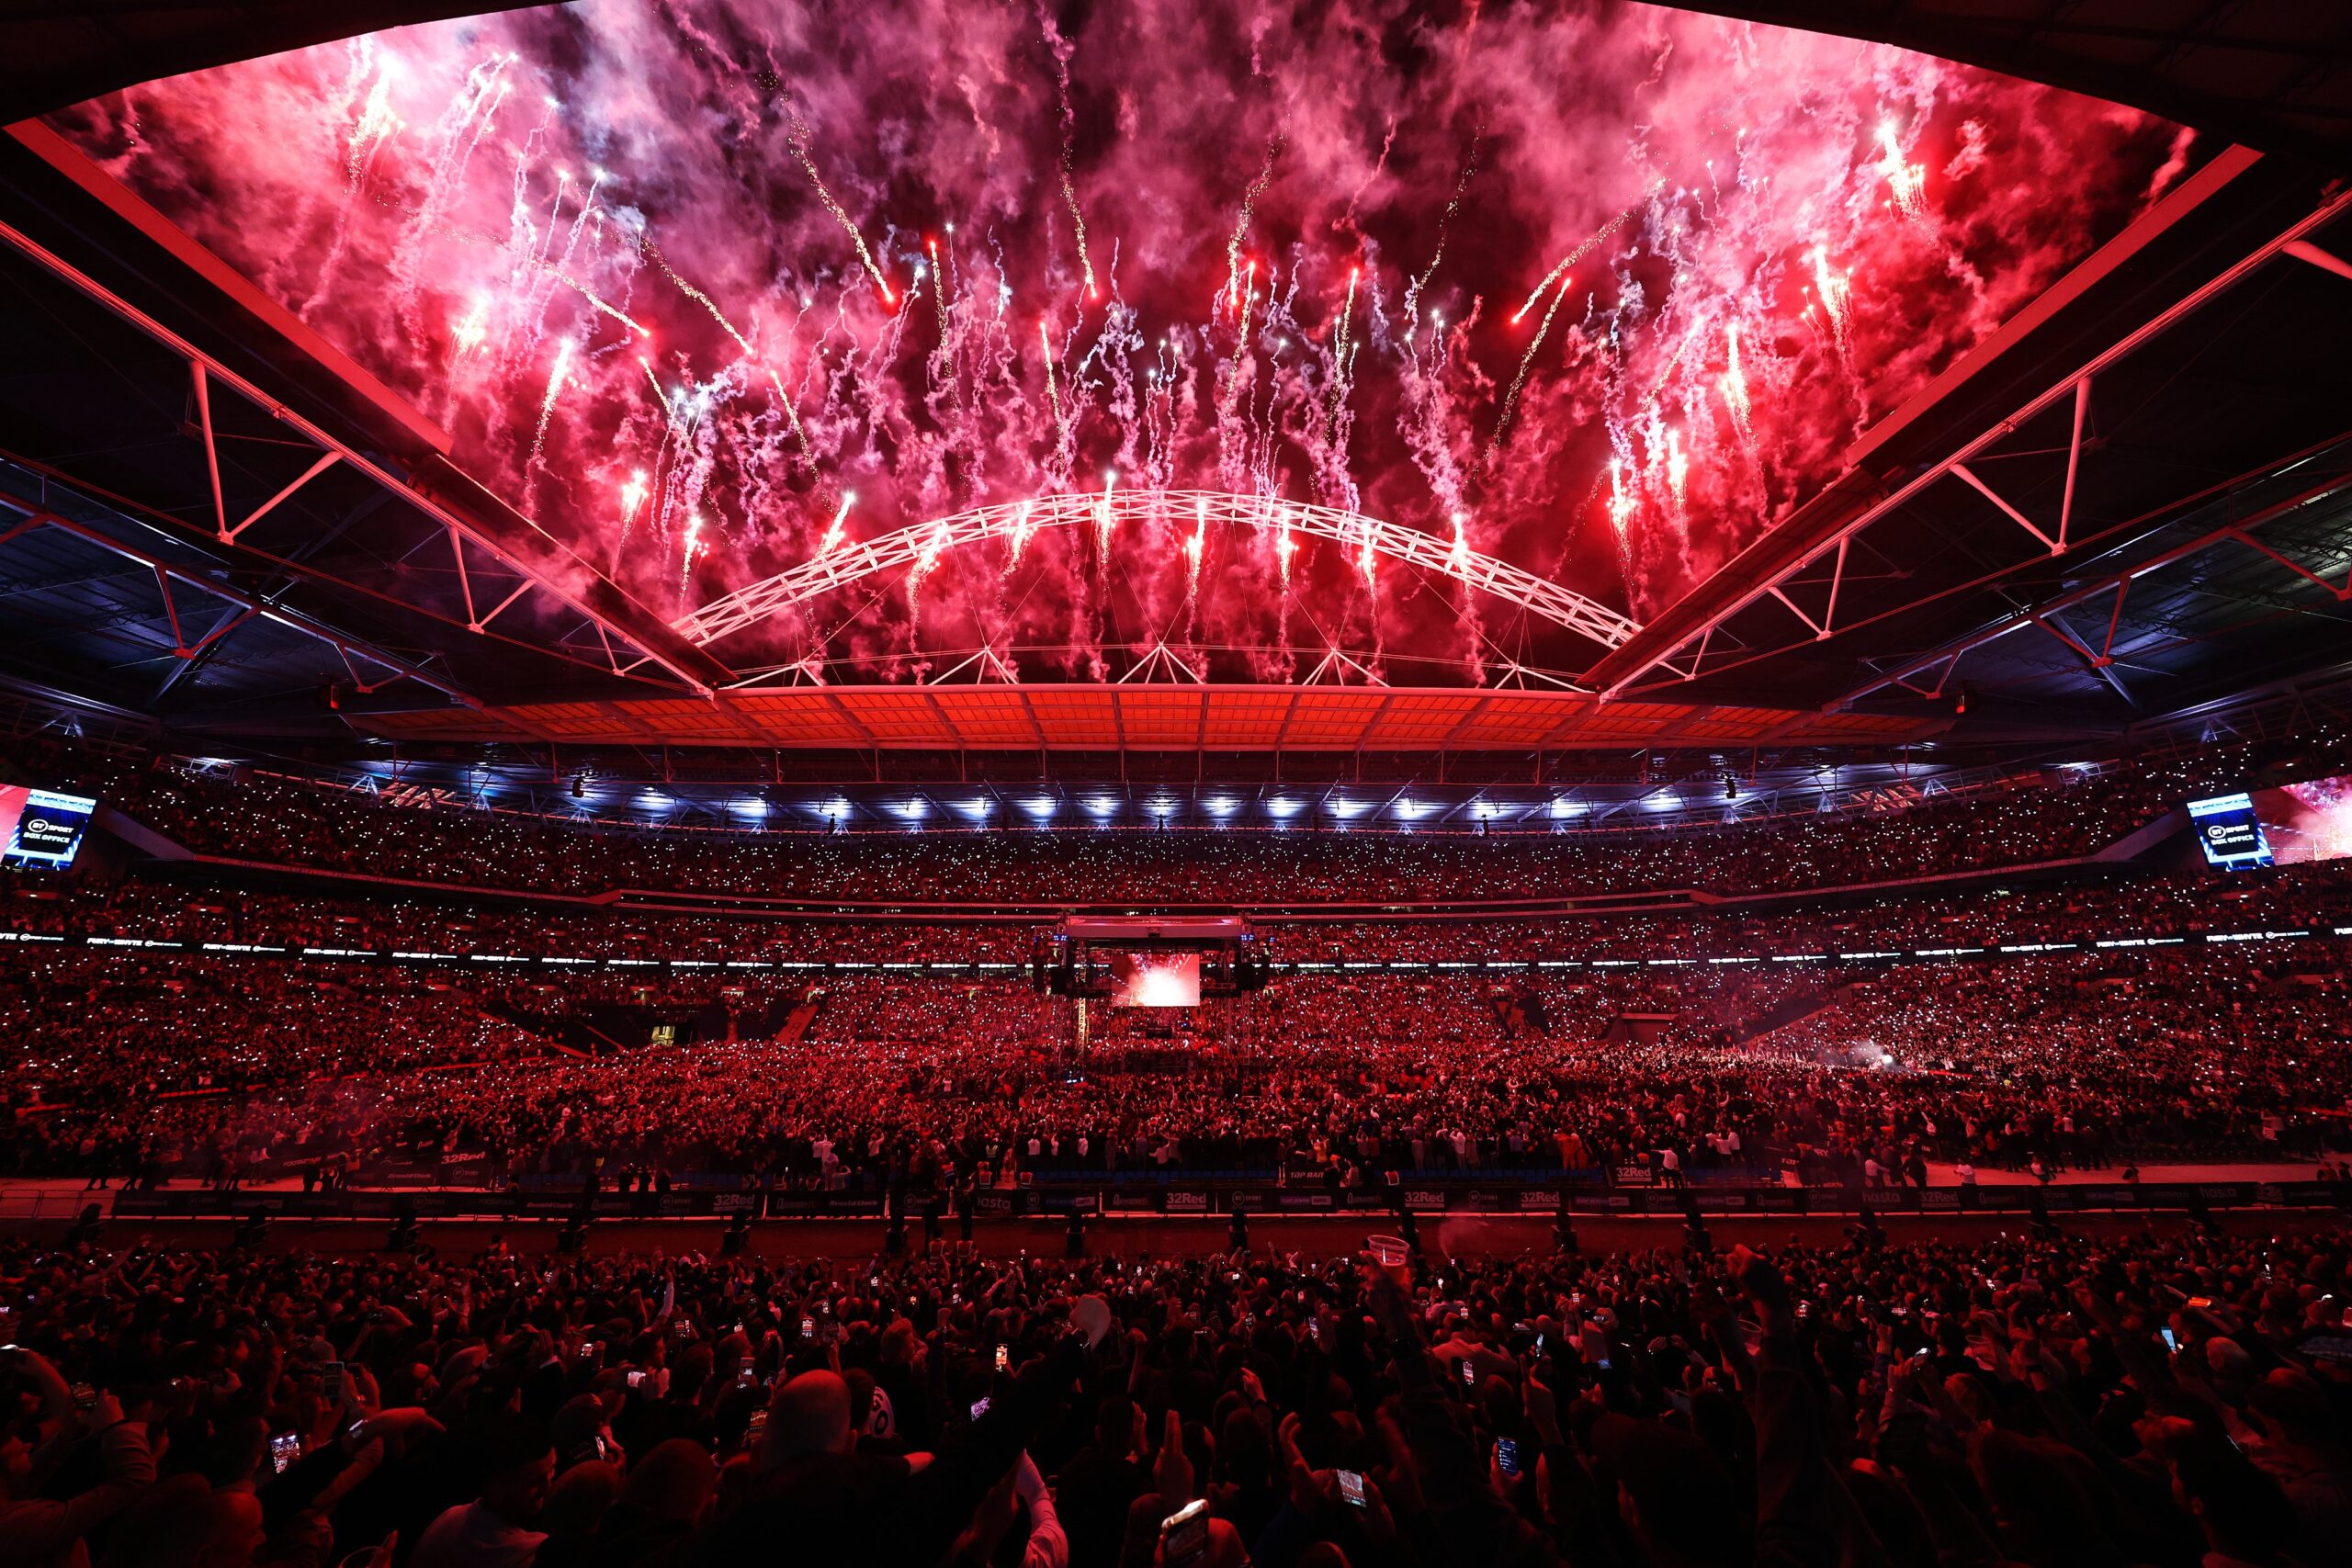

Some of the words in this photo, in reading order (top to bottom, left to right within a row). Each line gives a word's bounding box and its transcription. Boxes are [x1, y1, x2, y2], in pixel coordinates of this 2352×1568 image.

[48, 824, 74, 834] SPORT
[2225, 824, 2250, 834] SPORT
[23, 831, 41, 840] BOX
[41, 834, 71, 844] OFFICE
[2211, 837, 2228, 846] BOX
[2228, 834, 2256, 844] OFFICE
[441, 1151, 485, 1165] 32Red
[1616, 1167, 1651, 1178] 32Red
[713, 1194, 755, 1206] 32Red
[1166, 1192, 1206, 1204] 32Red
[1405, 1191, 1444, 1202] 32Red
[1521, 1191, 1560, 1202] 32Red
[1919, 1190, 1958, 1202] 32Red
